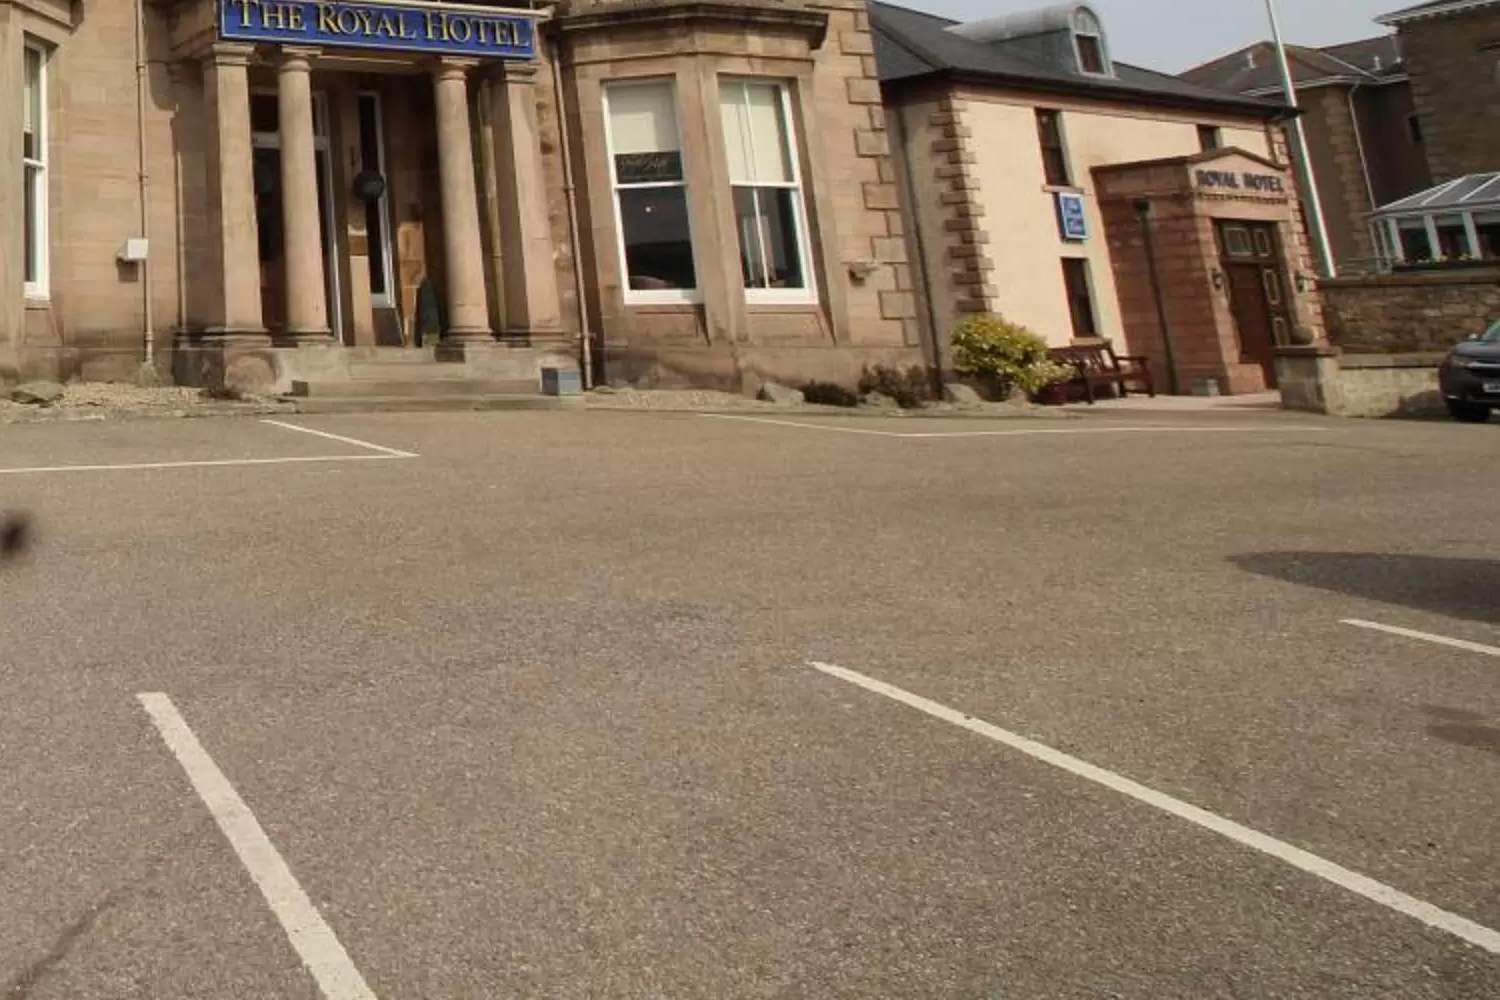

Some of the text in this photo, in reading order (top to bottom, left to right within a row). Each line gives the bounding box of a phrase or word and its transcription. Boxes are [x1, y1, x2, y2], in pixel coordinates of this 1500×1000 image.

[317, 3, 417, 39] ROYAL
[424, 8, 530, 47] HOTEL
[1195, 169, 1285, 192] ROYAL HOTEL
